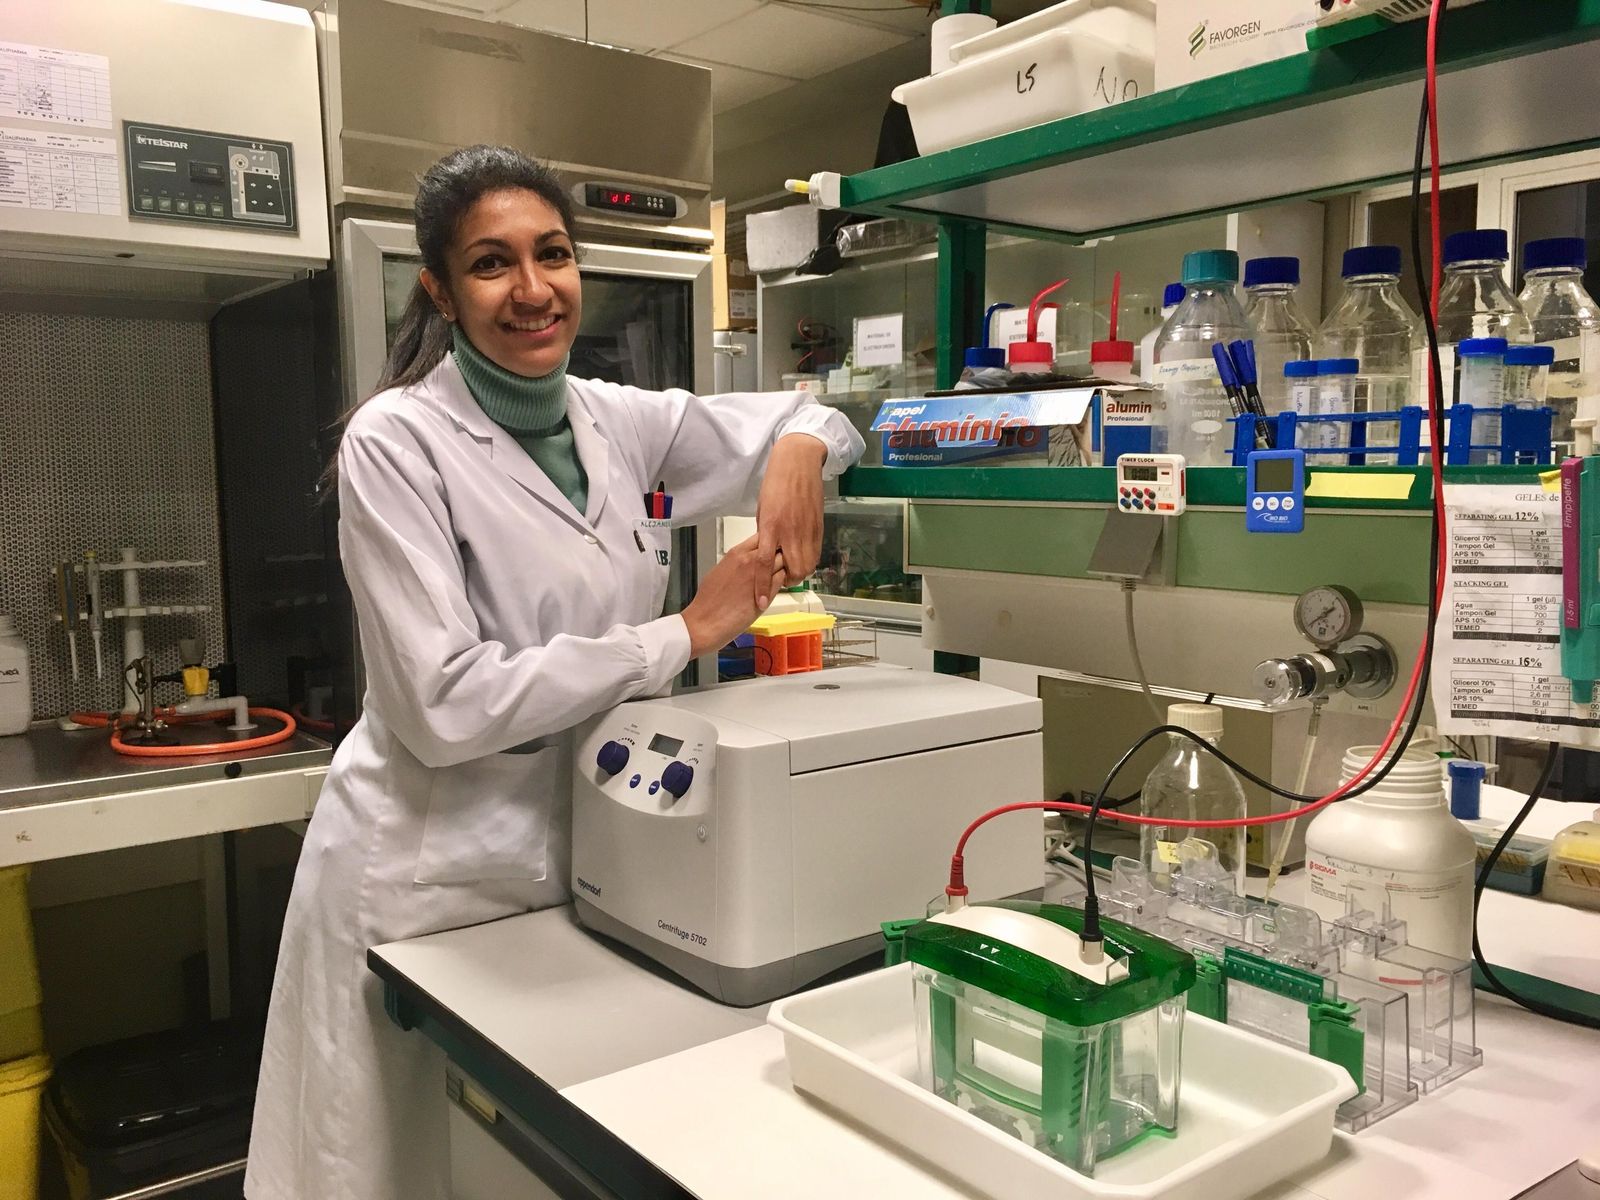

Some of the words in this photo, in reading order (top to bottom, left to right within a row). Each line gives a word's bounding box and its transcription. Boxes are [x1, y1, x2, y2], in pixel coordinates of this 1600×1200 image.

[1209, 20, 1262, 44] FAVORGEN
[888, 452, 944, 462] Profesional
[1515, 493, 1547, 502] GELES
[1549, 493, 1560, 502] de
[1564, 477, 1572, 529] Finnpipette
[1498, 513, 1513, 521] GEL
[1515, 511, 1539, 521] 12%
[1532, 596, 1543, 604] gel
[1453, 657, 1500, 665] SEPARATING
[1538, 676, 1549, 684] gel
[1314, 863, 1337, 876] SIGMA
[577, 876, 602, 898] eppendorf
[657, 919, 690, 940] Centrifuge
[690, 933, 708, 947] 5702
